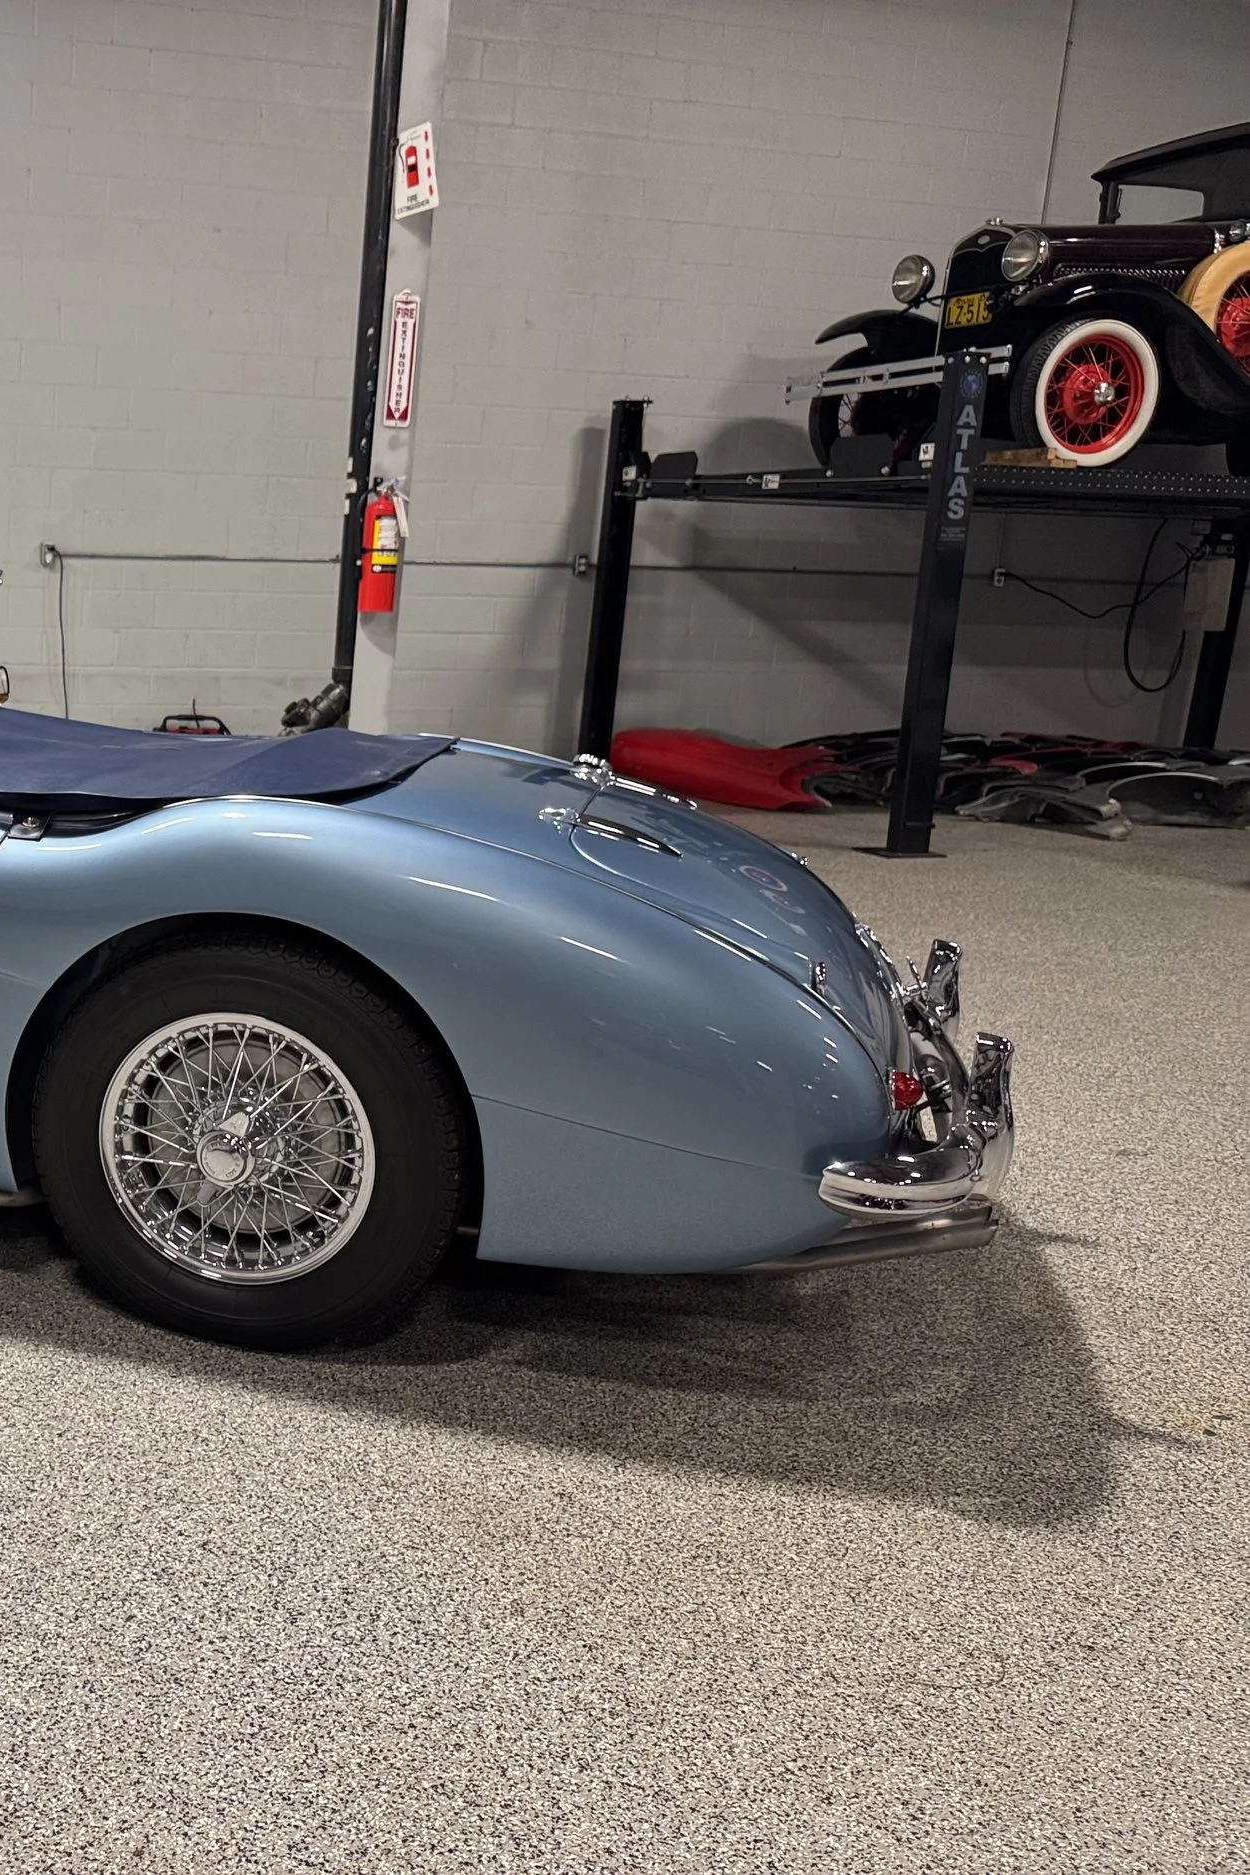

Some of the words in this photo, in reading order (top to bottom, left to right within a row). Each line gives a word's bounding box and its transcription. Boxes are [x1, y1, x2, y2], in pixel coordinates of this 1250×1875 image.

[396, 307, 415, 320] FIRE
[394, 321, 408, 413] EXTINGUISHER
[947, 404, 978, 520] ATLAS
